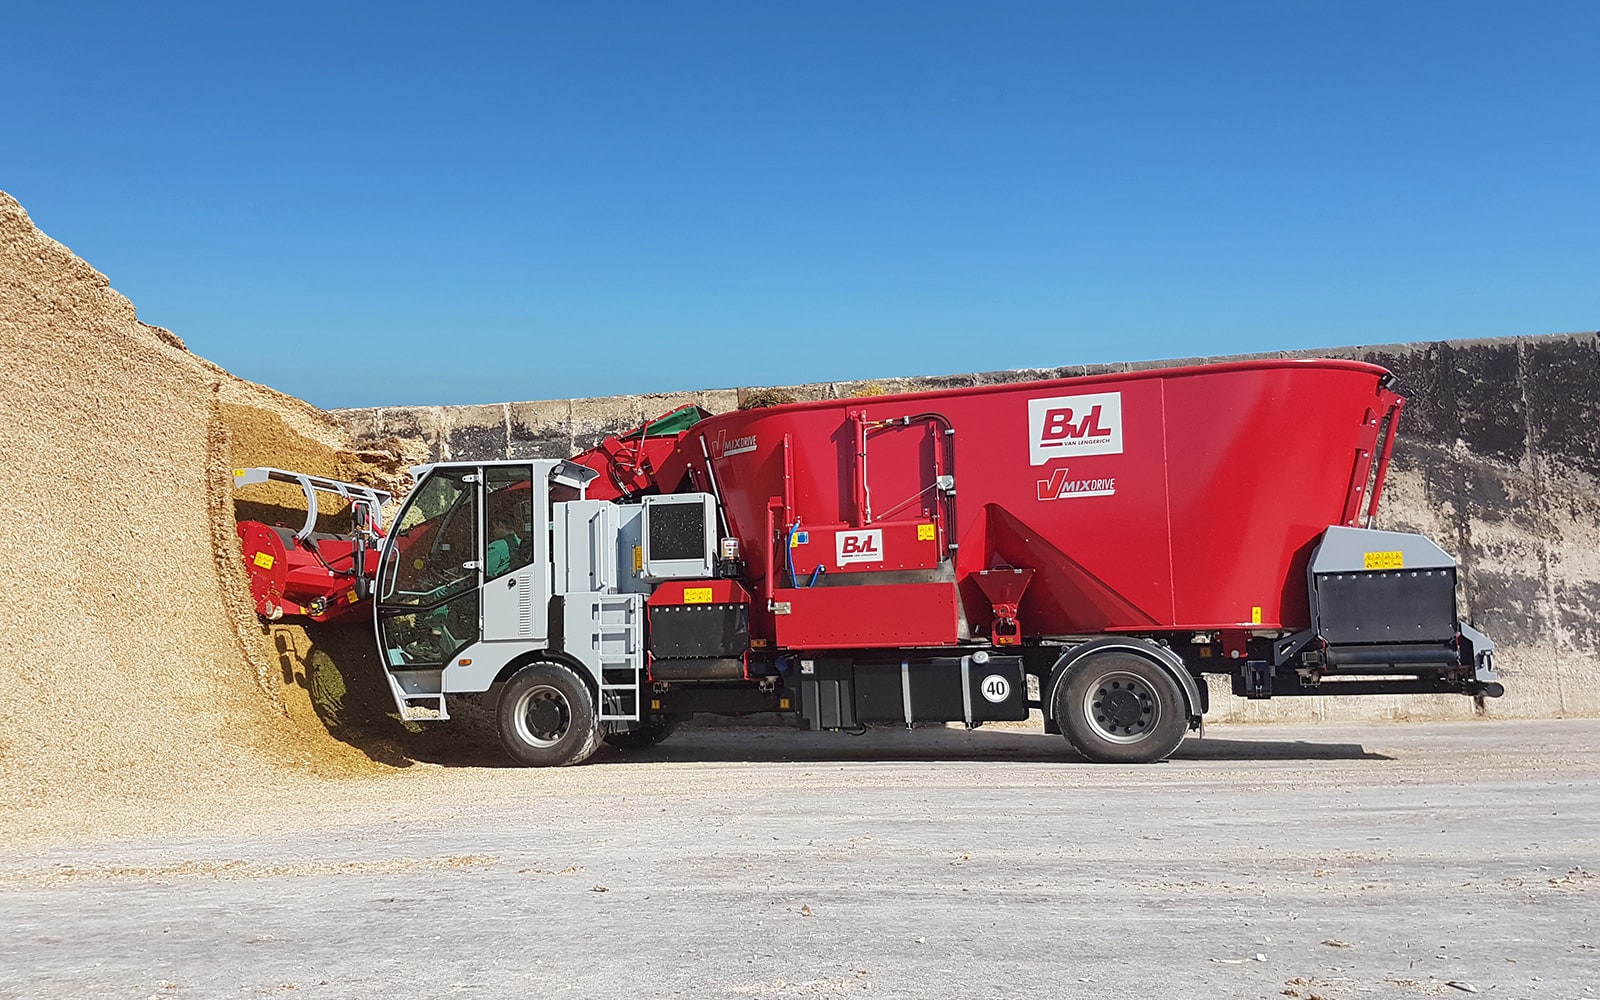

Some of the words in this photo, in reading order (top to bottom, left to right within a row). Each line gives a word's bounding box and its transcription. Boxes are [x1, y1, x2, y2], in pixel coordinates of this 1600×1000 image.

[1041, 405, 1111, 440] BvL
[842, 535, 877, 553] BvL
[987, 681, 1005, 695] 40
